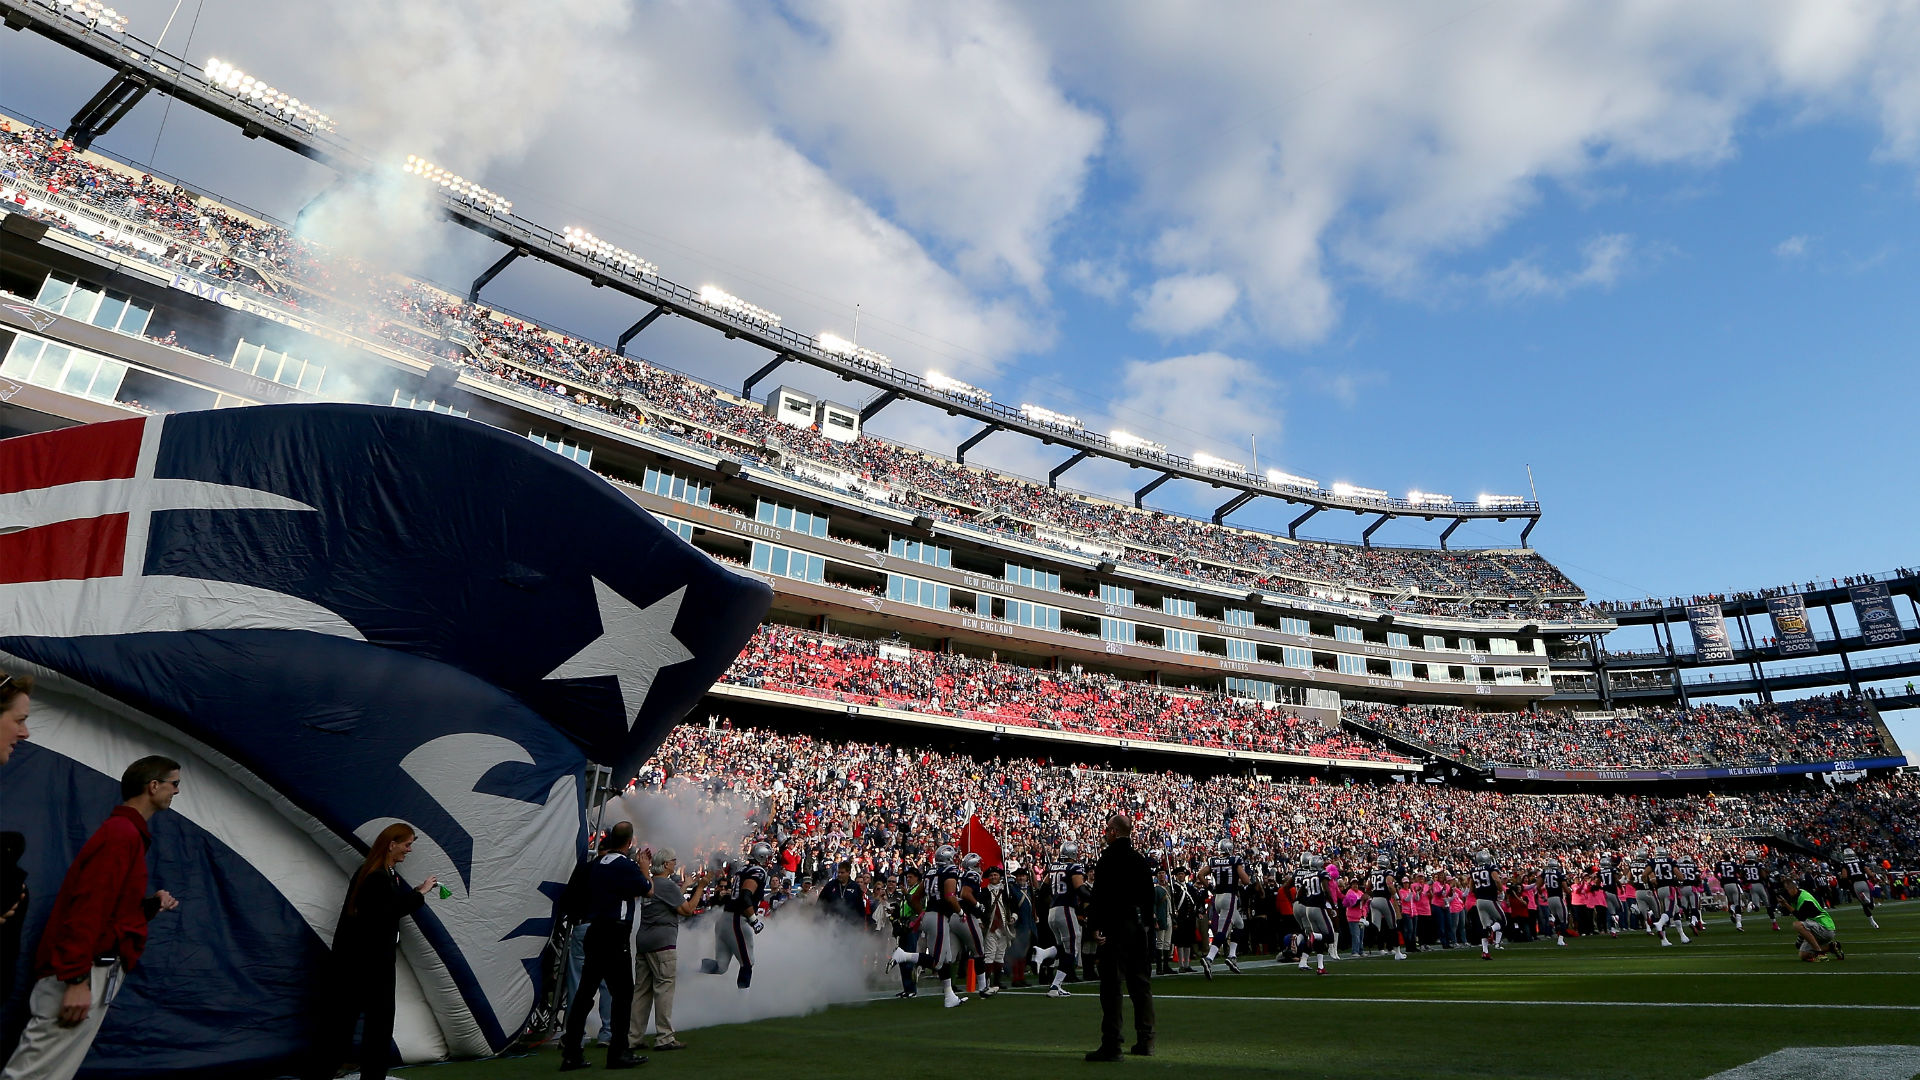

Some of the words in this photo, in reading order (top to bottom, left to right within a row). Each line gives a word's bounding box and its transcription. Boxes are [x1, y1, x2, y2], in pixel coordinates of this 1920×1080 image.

[172, 273, 240, 306] EMC
[244, 377, 281, 399] NEW
[735, 519, 781, 540] PATRIOTS
[963, 575, 980, 587] NEW
[981, 580, 1014, 594] ENGLAND
[962, 617, 978, 628] NEW
[980, 621, 1013, 635] ENGLAND
[1217, 625, 1246, 637] PATRIOTS
[1870, 632, 1897, 642] 2004
[1704, 651, 1727, 660] 2001
[1785, 643, 1811, 652] 2003
[1220, 660, 1249, 671] PATRIOTS
[1598, 771, 1629, 779] PATRIOTS
[1728, 768, 1744, 776] NEW
[1745, 766, 1778, 775] ENGLAND
[1210, 865, 1233, 885] 77
[1654, 863, 1673, 880] 43
[1720, 864, 1735, 878] 12
[1847, 862, 1863, 876] 11
[1049, 871, 1068, 896] 76
[1302, 876, 1321, 898] 30
[1371, 874, 1385, 892] 92
[1471, 870, 1491, 889] 59
[1544, 873, 1559, 889] 46
